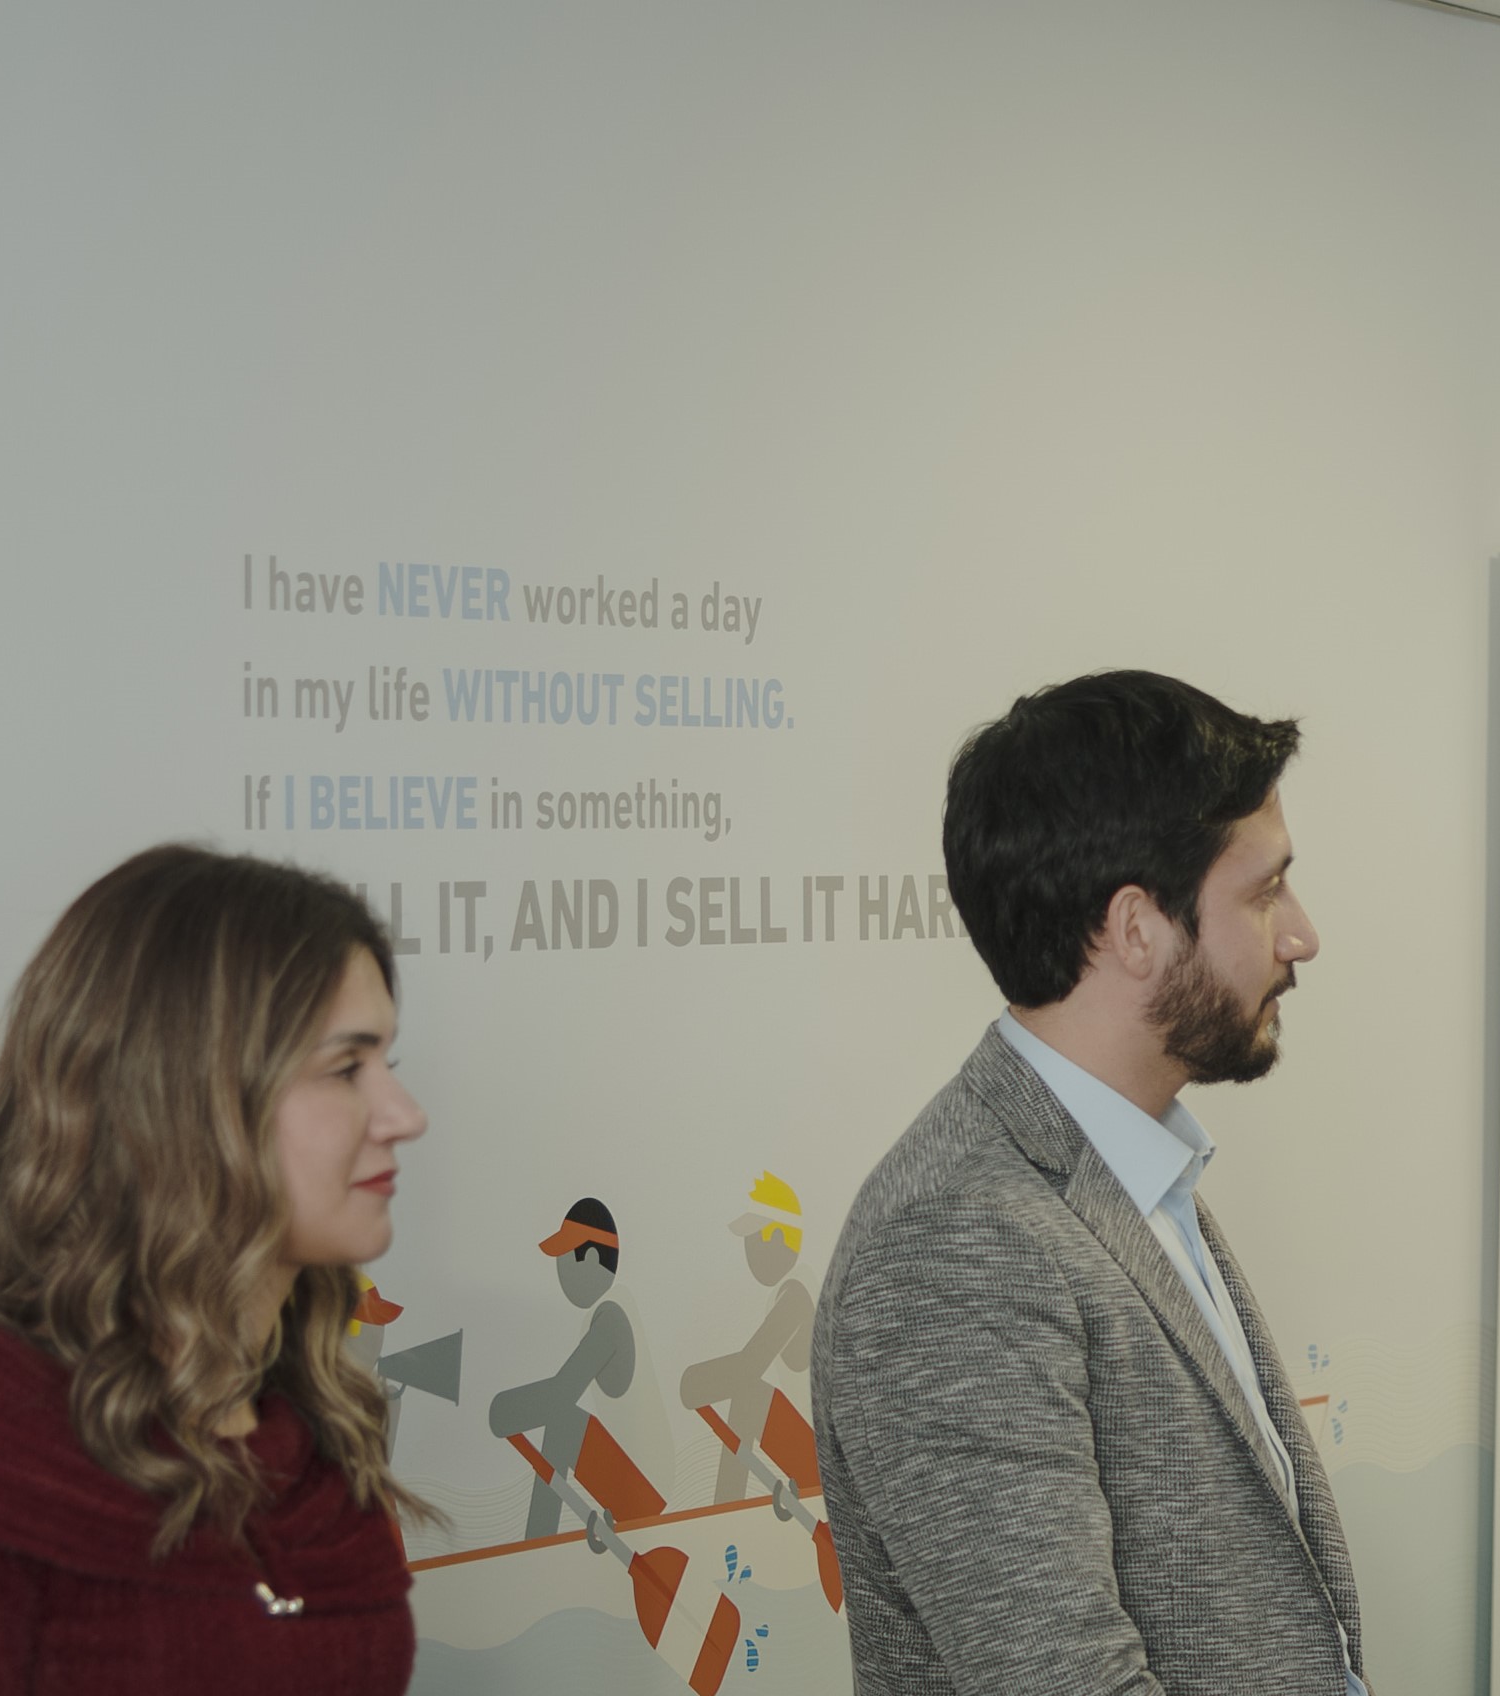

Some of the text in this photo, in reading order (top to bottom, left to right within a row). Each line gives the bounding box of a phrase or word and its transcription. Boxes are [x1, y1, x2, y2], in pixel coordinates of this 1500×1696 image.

[243, 553, 762, 645] I have NEVER worked a day
[243, 661, 795, 734] in my life WITHOUT SELLING.
[243, 774, 733, 843] If I BELIEVE in something,
[439, 880, 494, 964] IT,
[510, 878, 620, 953] AND
[636, 877, 648, 948] I
[664, 875, 788, 949] SELL
[803, 875, 845, 943] IT
[859, 874, 972, 942] HAR
